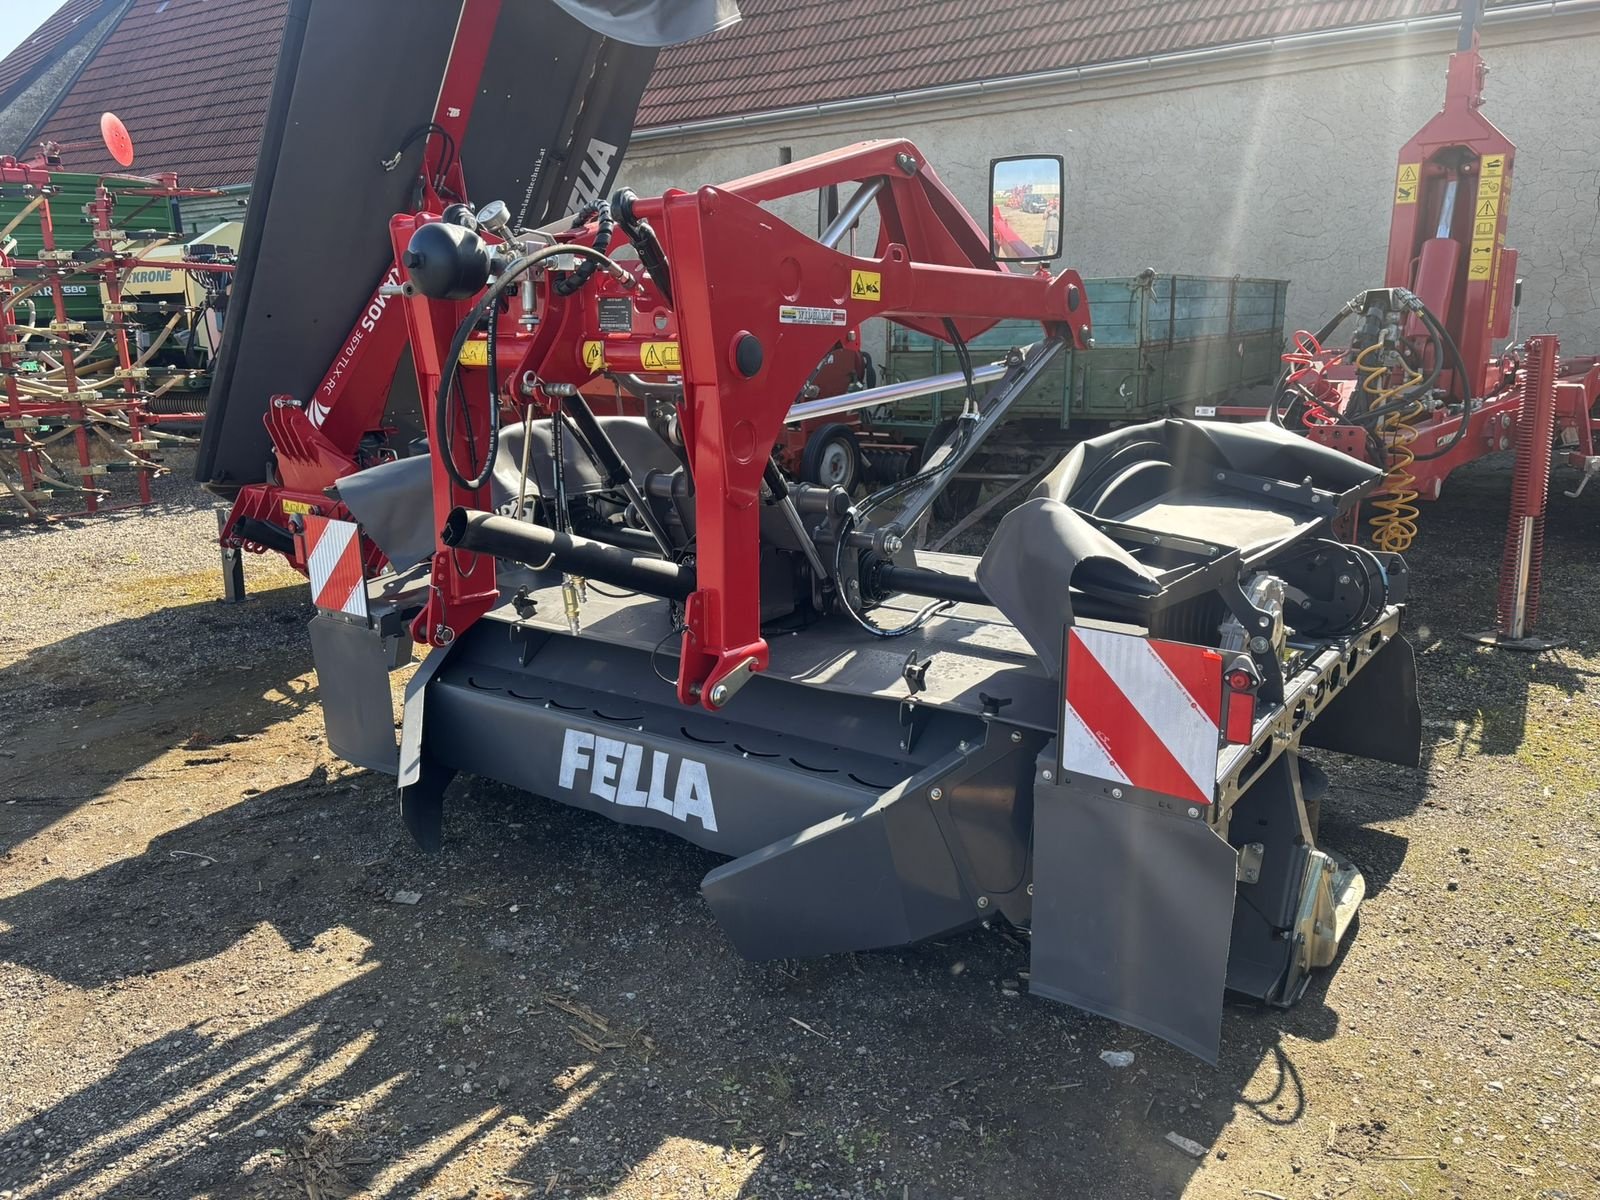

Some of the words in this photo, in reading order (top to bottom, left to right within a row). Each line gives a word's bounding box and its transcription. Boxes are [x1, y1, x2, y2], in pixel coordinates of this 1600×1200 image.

[563, 137, 619, 218] ELLA
[61, 285, 87, 295] 680
[132, 269, 172, 284] KRONE
[345, 329, 364, 357] 3670
[323, 355, 350, 396] TLX-RC
[558, 728, 719, 833] FELLA
